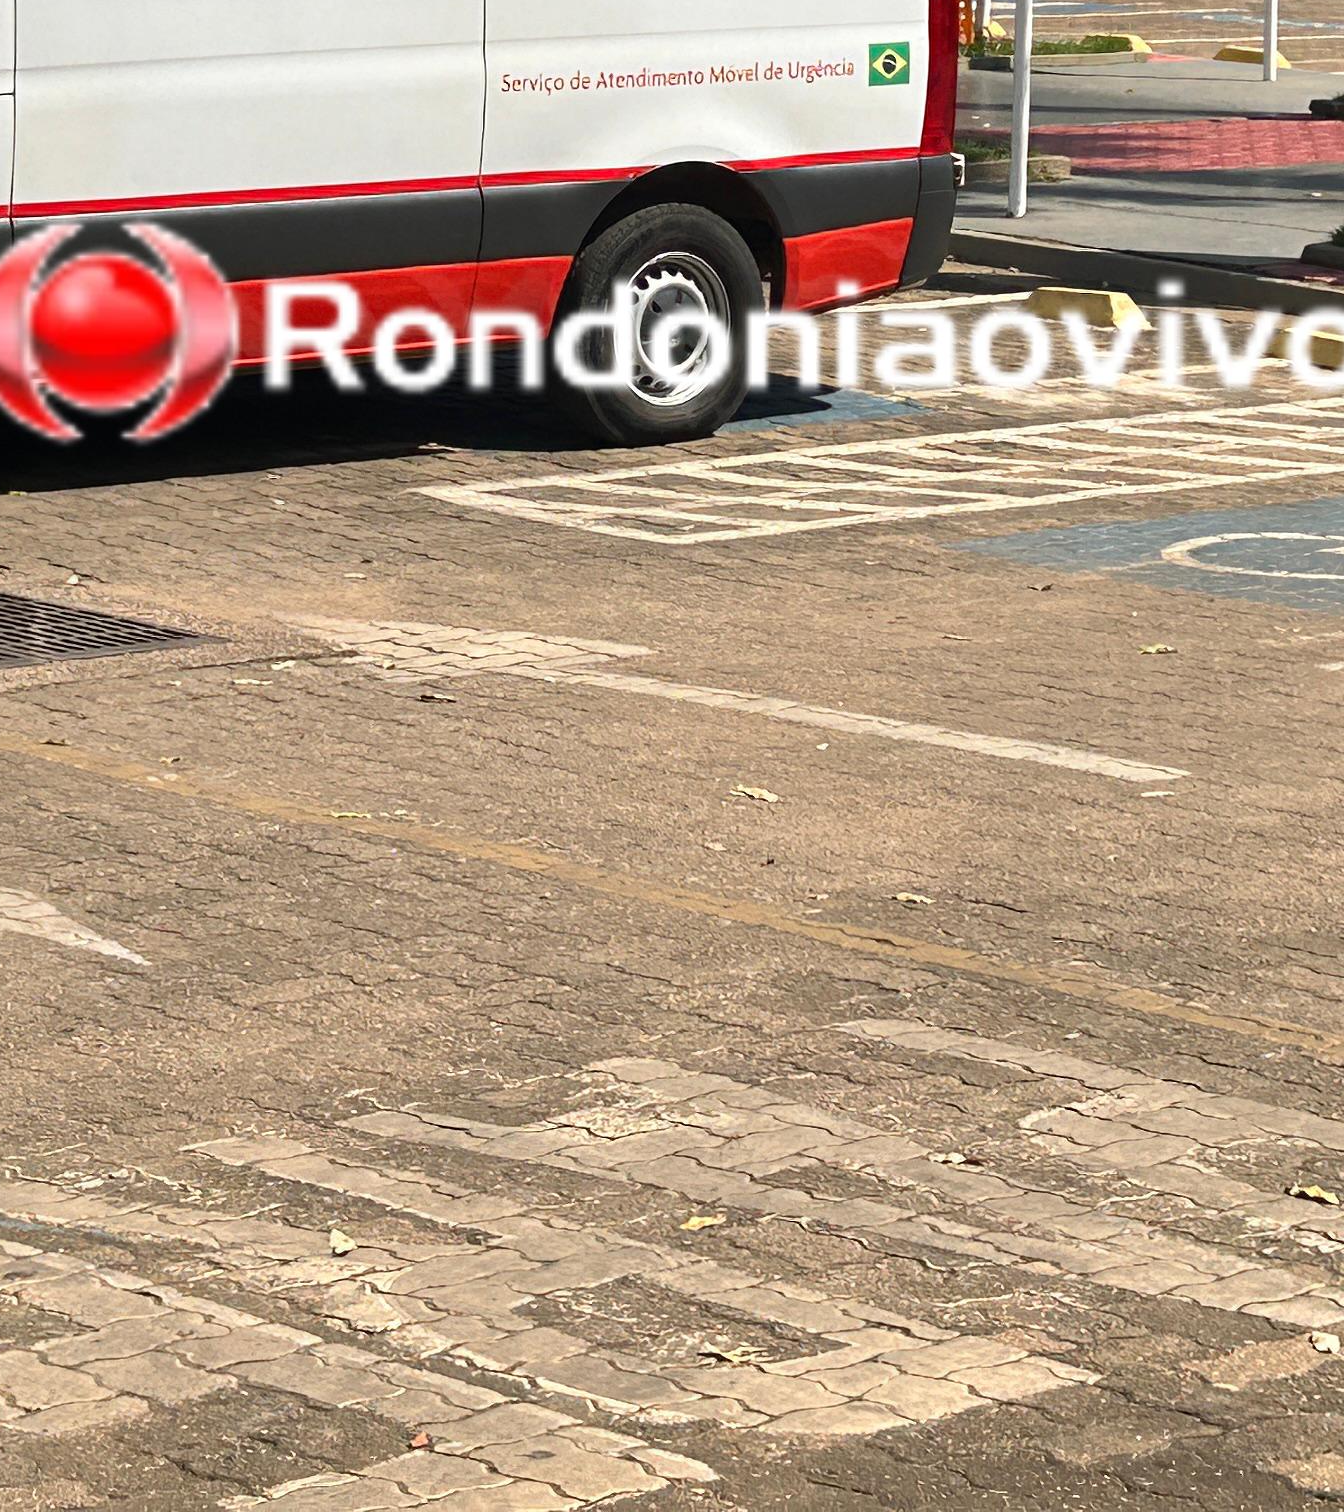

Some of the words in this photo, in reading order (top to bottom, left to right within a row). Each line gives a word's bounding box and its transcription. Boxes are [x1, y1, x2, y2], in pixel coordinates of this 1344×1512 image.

[501, 73, 565, 96] Serviço
[570, 70, 591, 90] de
[596, 65, 704, 90] Atendimento
[709, 60, 759, 85] Móvel
[763, 61, 783, 80] de
[788, 58, 855, 84] Urgência
